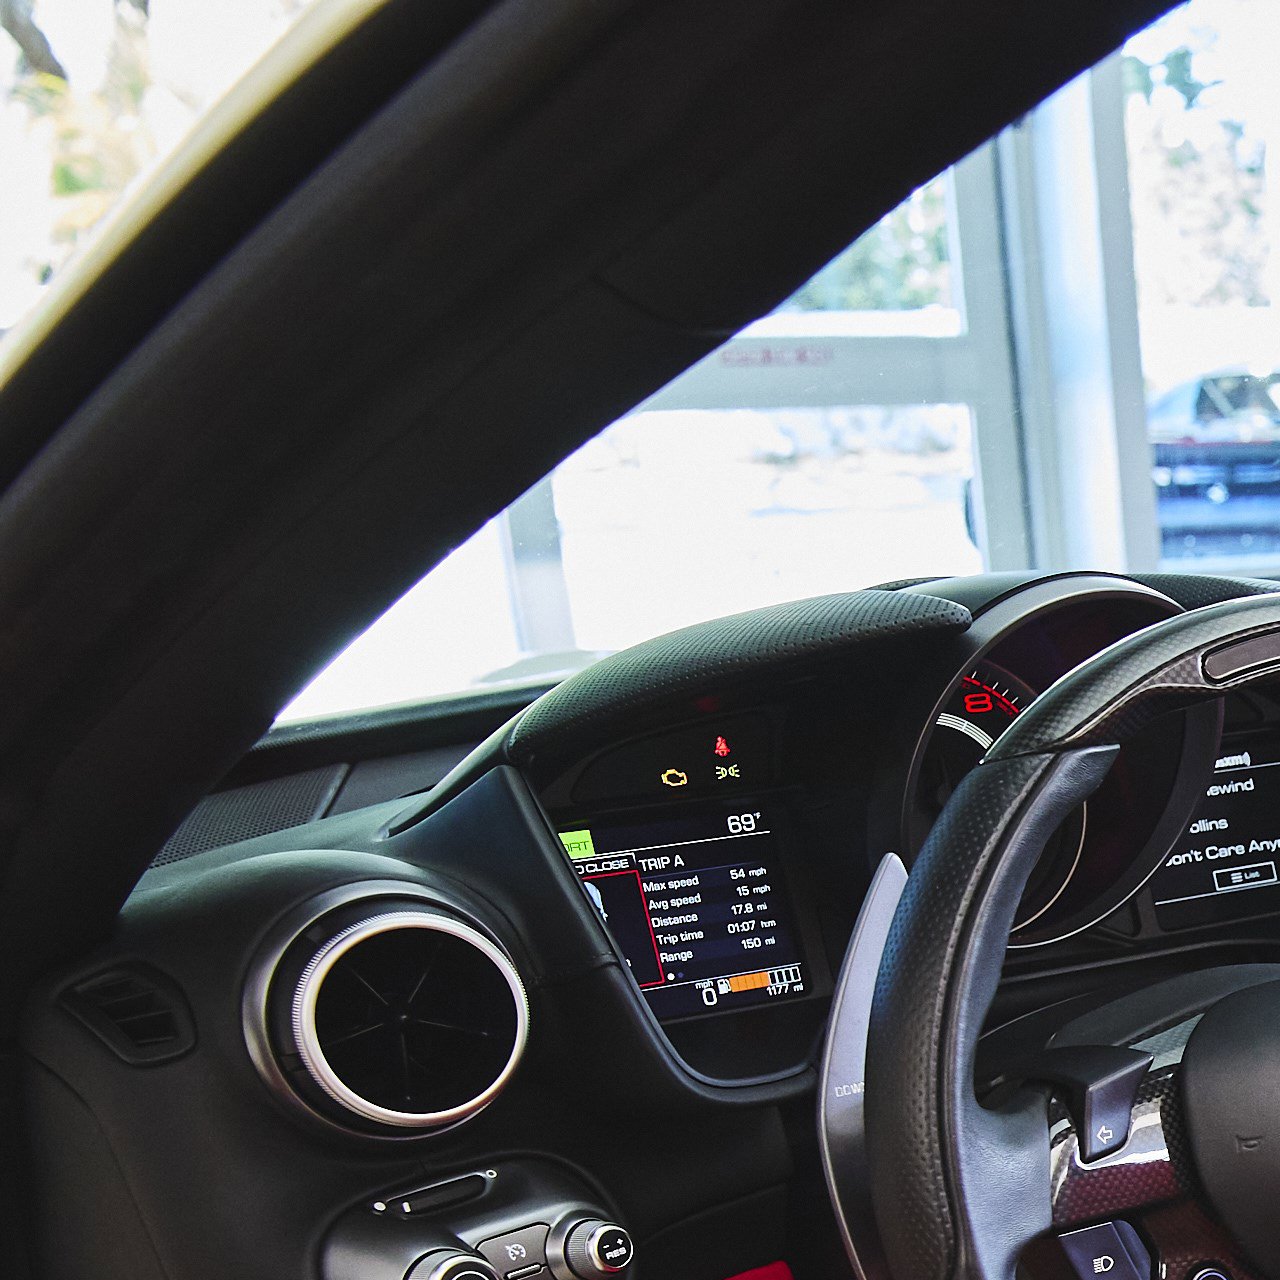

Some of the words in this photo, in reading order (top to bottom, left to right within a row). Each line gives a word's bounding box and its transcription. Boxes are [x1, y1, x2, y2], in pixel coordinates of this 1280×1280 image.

[1207, 778, 1255, 796] ewind
[1189, 819, 1229, 834] ollins
[638, 856, 671, 872] TRIP
[674, 854, 685, 868] A
[1166, 849, 1203, 867] on't
[1205, 845, 1246, 860] Care
[585, 858, 630, 873] CLOSE
[642, 881, 667, 893] Max
[668, 875, 700, 890] speed
[729, 868, 746, 880] 54
[748, 867, 767, 877] mph
[648, 900, 669, 910] Avg
[670, 893, 702, 908] speed
[736, 885, 750, 897] 15
[752, 884, 771, 894] mph
[651, 913, 699, 928] Distance
[731, 902, 754, 915] 17.8
[756, 902, 768, 911] mi
[656, 933, 679, 945] Trip
[680, 930, 704, 942] time
[727, 920, 756, 934] 01:07
[660, 950, 694, 963] Range
[741, 937, 762, 949] 150
[765, 936, 776, 945] mi
[695, 979, 714, 989] mph
[766, 984, 789, 996] 1177
[793, 983, 804, 992] mi
[605, 1246, 627, 1260] RES
